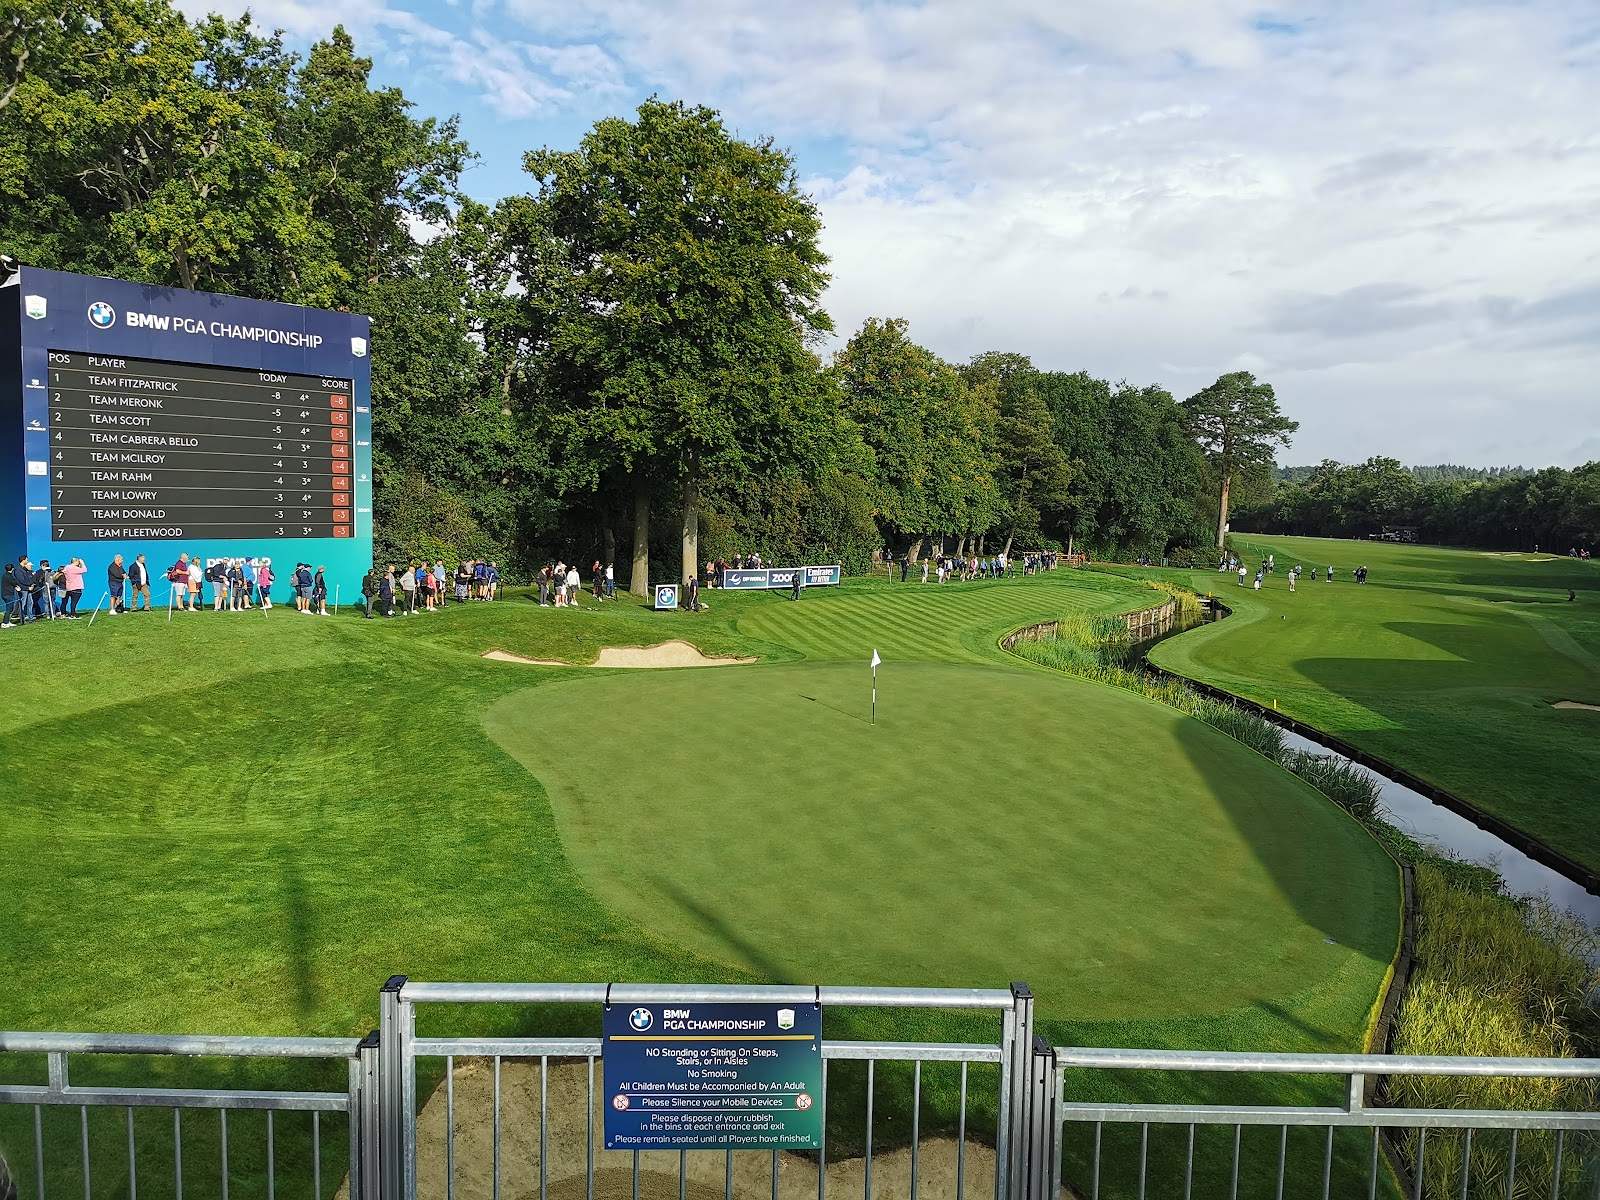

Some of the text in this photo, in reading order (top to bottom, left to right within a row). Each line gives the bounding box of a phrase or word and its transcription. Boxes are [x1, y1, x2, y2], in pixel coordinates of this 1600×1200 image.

[126, 311, 323, 349] BMW PGA CHAMPIONSHIP
[49, 353, 126, 368] POS PLAYER
[259, 373, 288, 383] TODAY
[54, 374, 60, 382] 1
[88, 376, 116, 386] TEAM
[119, 378, 178, 391] FITZPATRICK
[272, 392, 280, 400] -8
[322, 380, 348, 390] SCORE
[54, 393, 60, 402] 2
[89, 395, 116, 406] TEAM
[120, 397, 163, 408] MERONK
[272, 408, 281, 416] -5
[55, 412, 62, 422] 2
[90, 414, 118, 424] TEAM
[120, 416, 151, 426] SCOTT
[56, 432, 62, 440] 4
[90, 434, 118, 444] TEAM
[120, 435, 167, 446] CABRERA
[170, 437, 198, 447] BELLO
[56, 452, 62, 460] 4
[90, 452, 118, 462] TEAM
[122, 453, 165, 464] MCILROY
[302, 460, 308, 468] 3
[56, 472, 63, 480] 4
[91, 472, 118, 481] TEAM
[122, 472, 152, 482] RAHM
[274, 476, 283, 484] -4
[57, 490, 64, 499] 7
[92, 490, 119, 500] TEAM
[122, 491, 157, 500] LOWRY
[274, 494, 283, 502] -3
[58, 510, 64, 518] 7
[92, 510, 120, 519] TEAM
[122, 510, 166, 518] DONALD
[274, 510, 284, 518] -3
[58, 529, 64, 538] 7
[92, 529, 120, 538] TEAM
[123, 528, 182, 538] FLEETWOOD
[274, 528, 284, 536] -3
[663, 1010, 690, 1018] BMW
[663, 1020, 766, 1030] PGA CHAMPIONSHIP
[646, 1048, 660, 1056] NO
[662, 1048, 698, 1058] Standing
[710, 1048, 736, 1058] Sitting
[738, 1048, 750, 1056] On
[752, 1048, 778, 1058] Steps,
[676, 1057, 702, 1066] Stairs,
[714, 1057, 722, 1065] In
[724, 1057, 748, 1065] Aisles
[688, 1070, 738, 1080] No Smoking
[620, 1082, 630, 1090] All
[632, 1082, 666, 1090] Children
[668, 1082, 688, 1090] Must
[690, 1082, 700, 1090] be
[702, 1082, 757, 1091] Accompanied
[758, 1082, 769, 1092] by
[642, 1098, 670, 1106] Please
[672, 1098, 700, 1106] Silence
[722, 1098, 750, 1106] Mobile
[752, 1098, 782, 1106] Devices
[652, 1114, 679, 1122] Please
[681, 1114, 712, 1123] dispose
[724, 1115, 742, 1123] your
[650, 1122, 663, 1130] the
[664, 1122, 682, 1130] bins
[684, 1122, 692, 1130] at
[694, 1122, 714, 1130] each
[770, 1122, 784, 1130] exit
[615, 1134, 810, 1144] Please remain seated until all Players have finished
